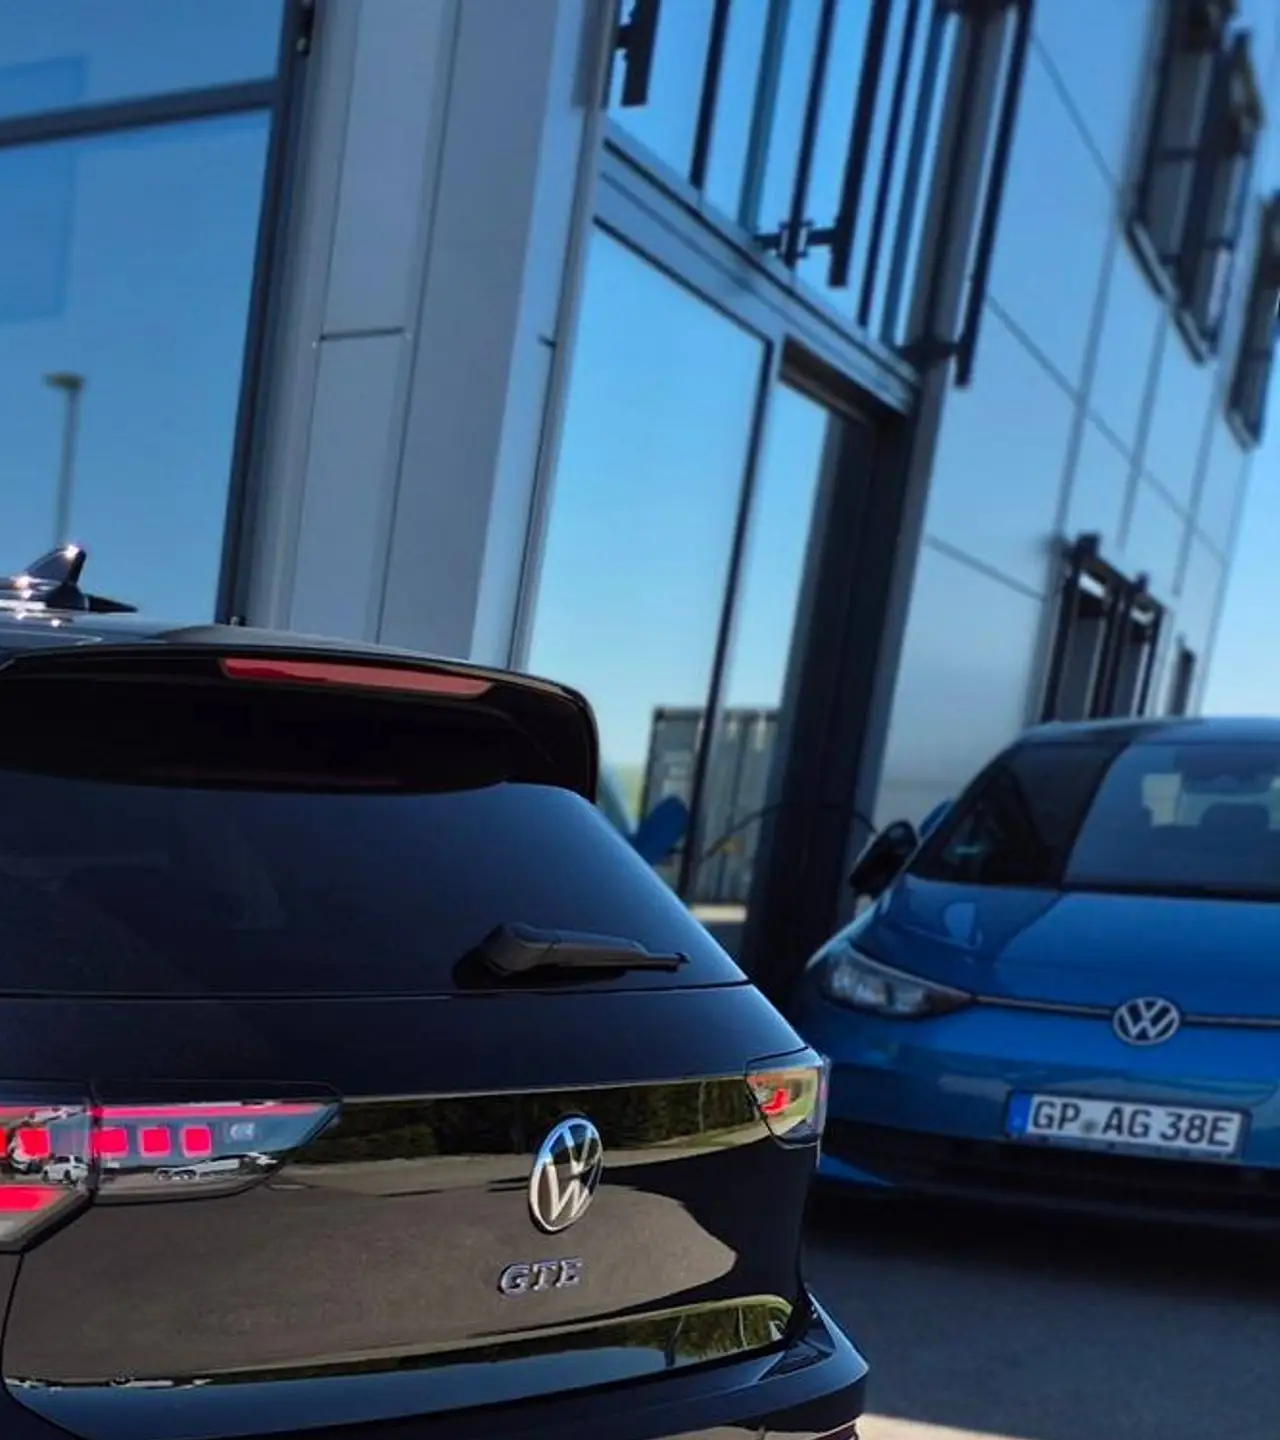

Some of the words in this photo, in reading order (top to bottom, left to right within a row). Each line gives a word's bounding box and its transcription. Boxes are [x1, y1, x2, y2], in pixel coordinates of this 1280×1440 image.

[1031, 1101, 1081, 1131] GP
[1101, 1106, 1152, 1139] AG
[1159, 1111, 1235, 1148] 38E
[498, 1257, 583, 1298] GTE
